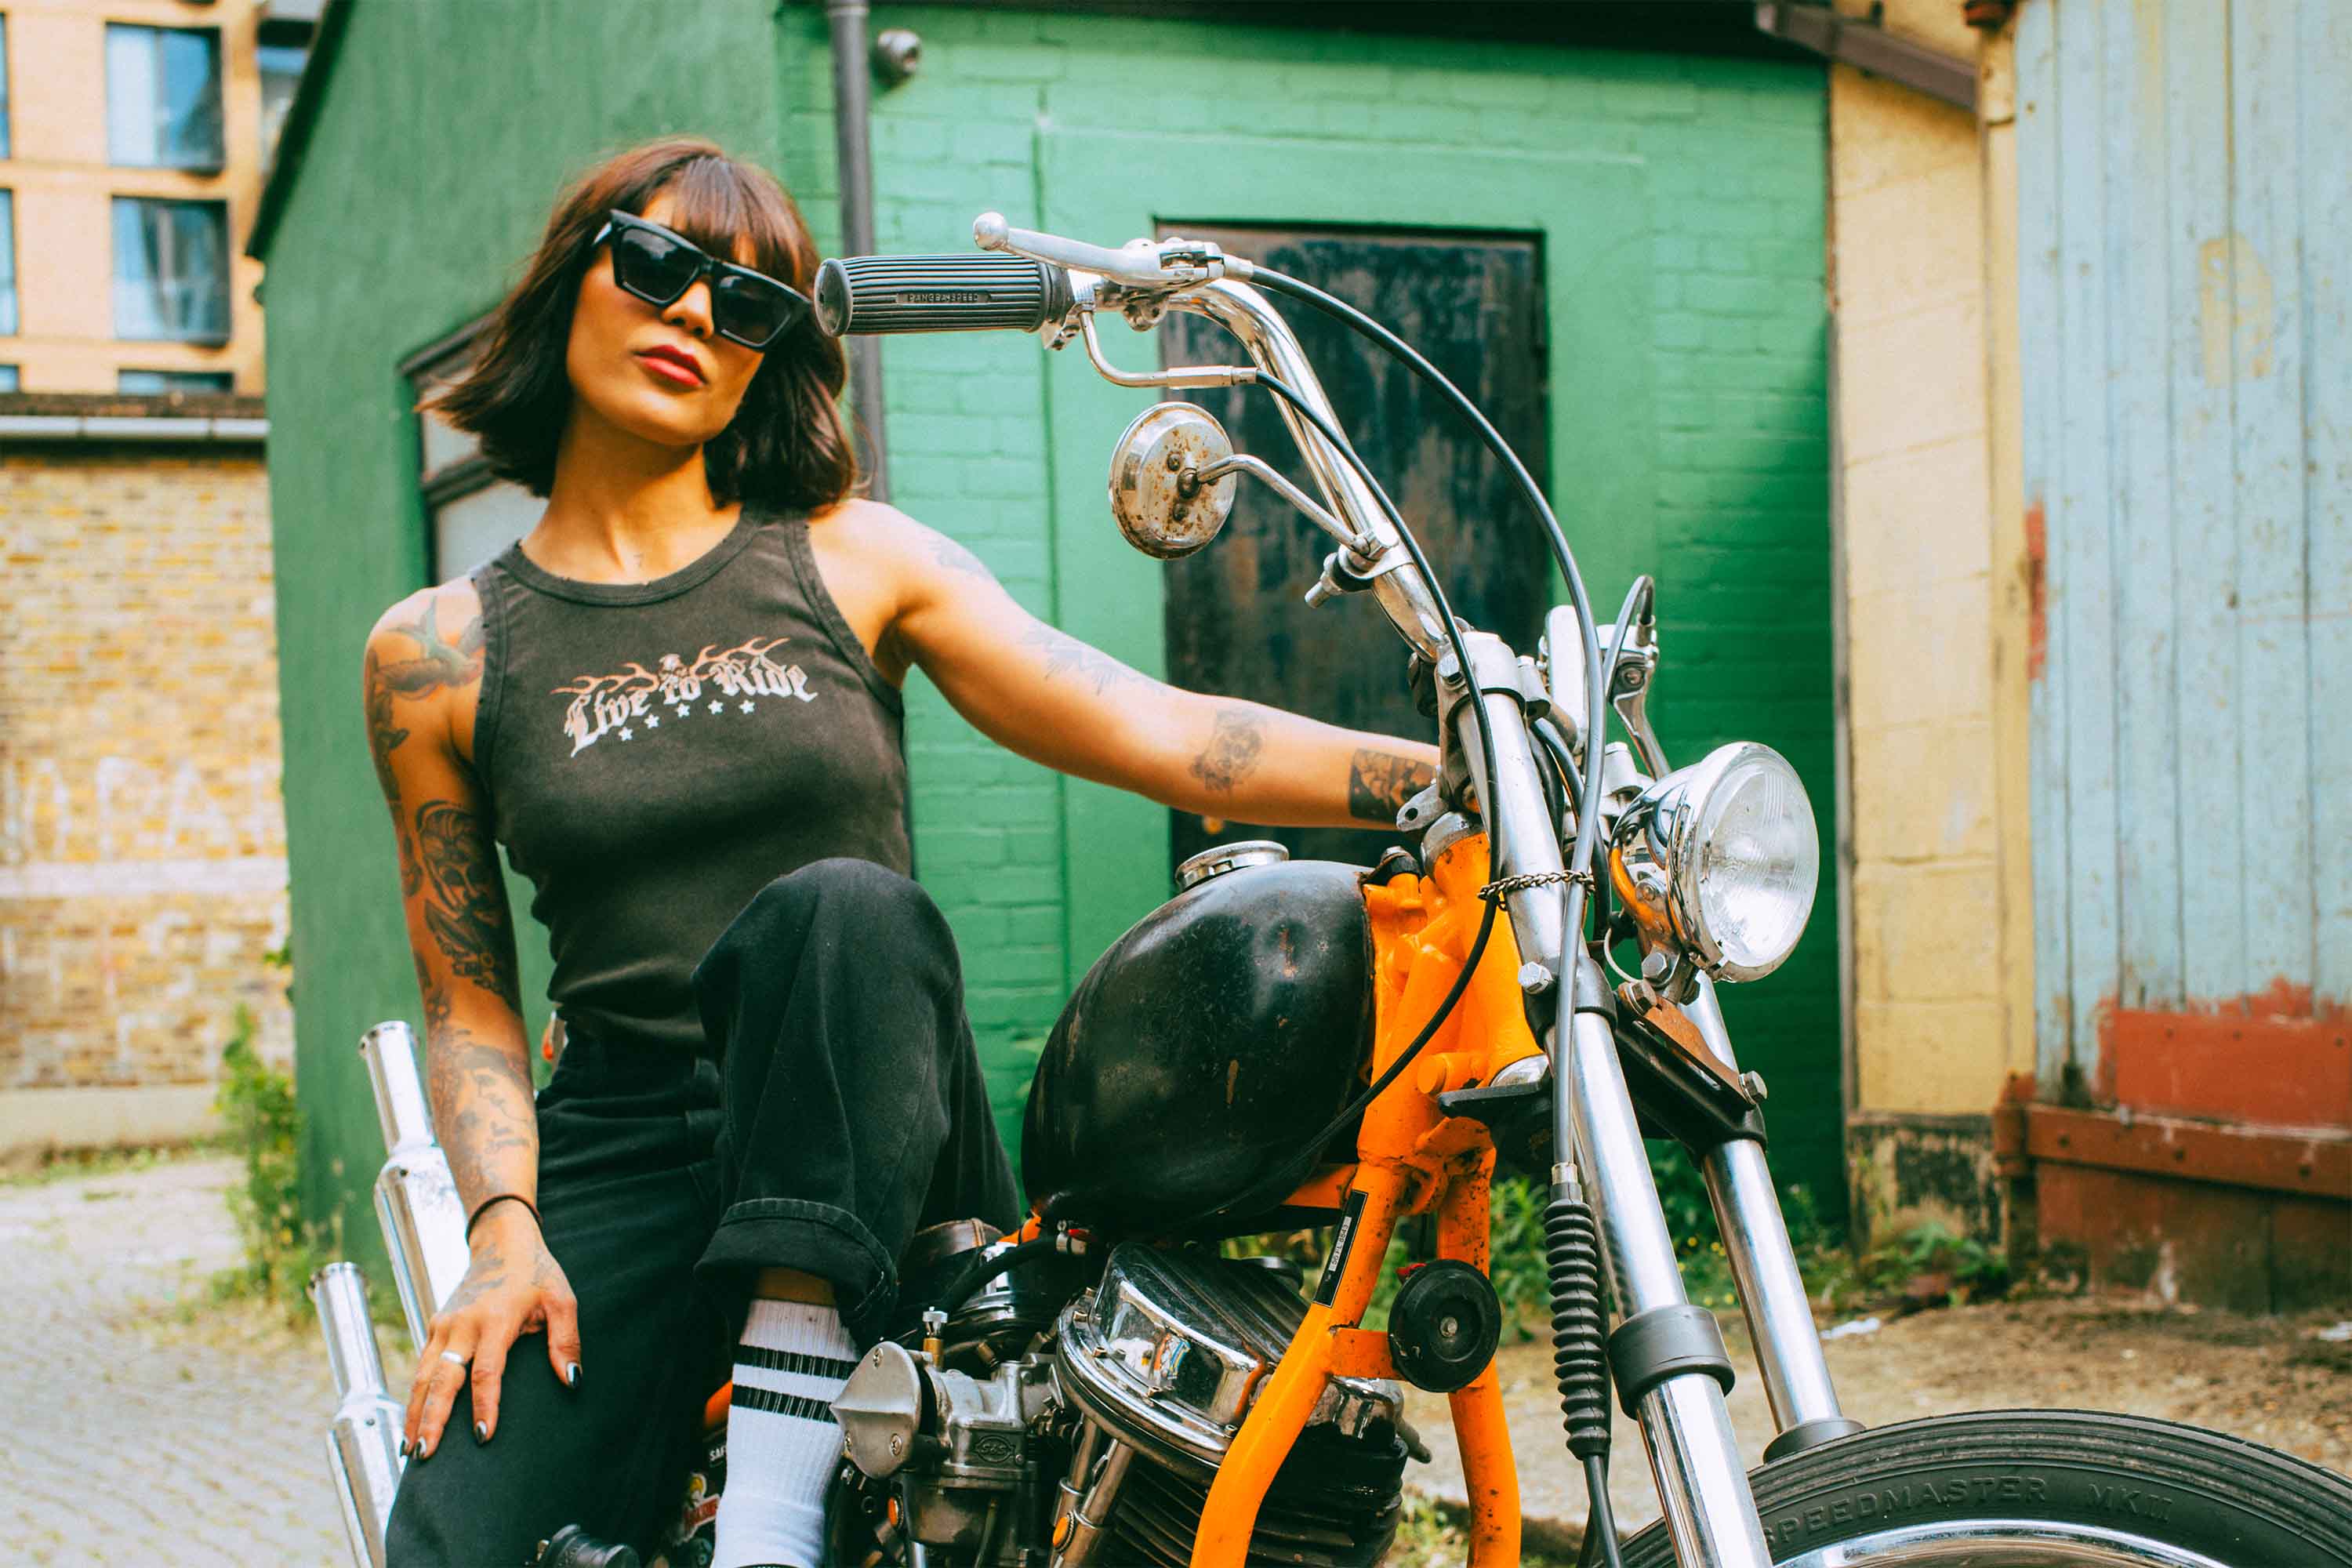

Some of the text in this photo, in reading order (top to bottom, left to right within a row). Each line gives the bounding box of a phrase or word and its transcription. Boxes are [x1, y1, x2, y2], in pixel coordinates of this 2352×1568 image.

[564, 653, 818, 757] Live to Ride
